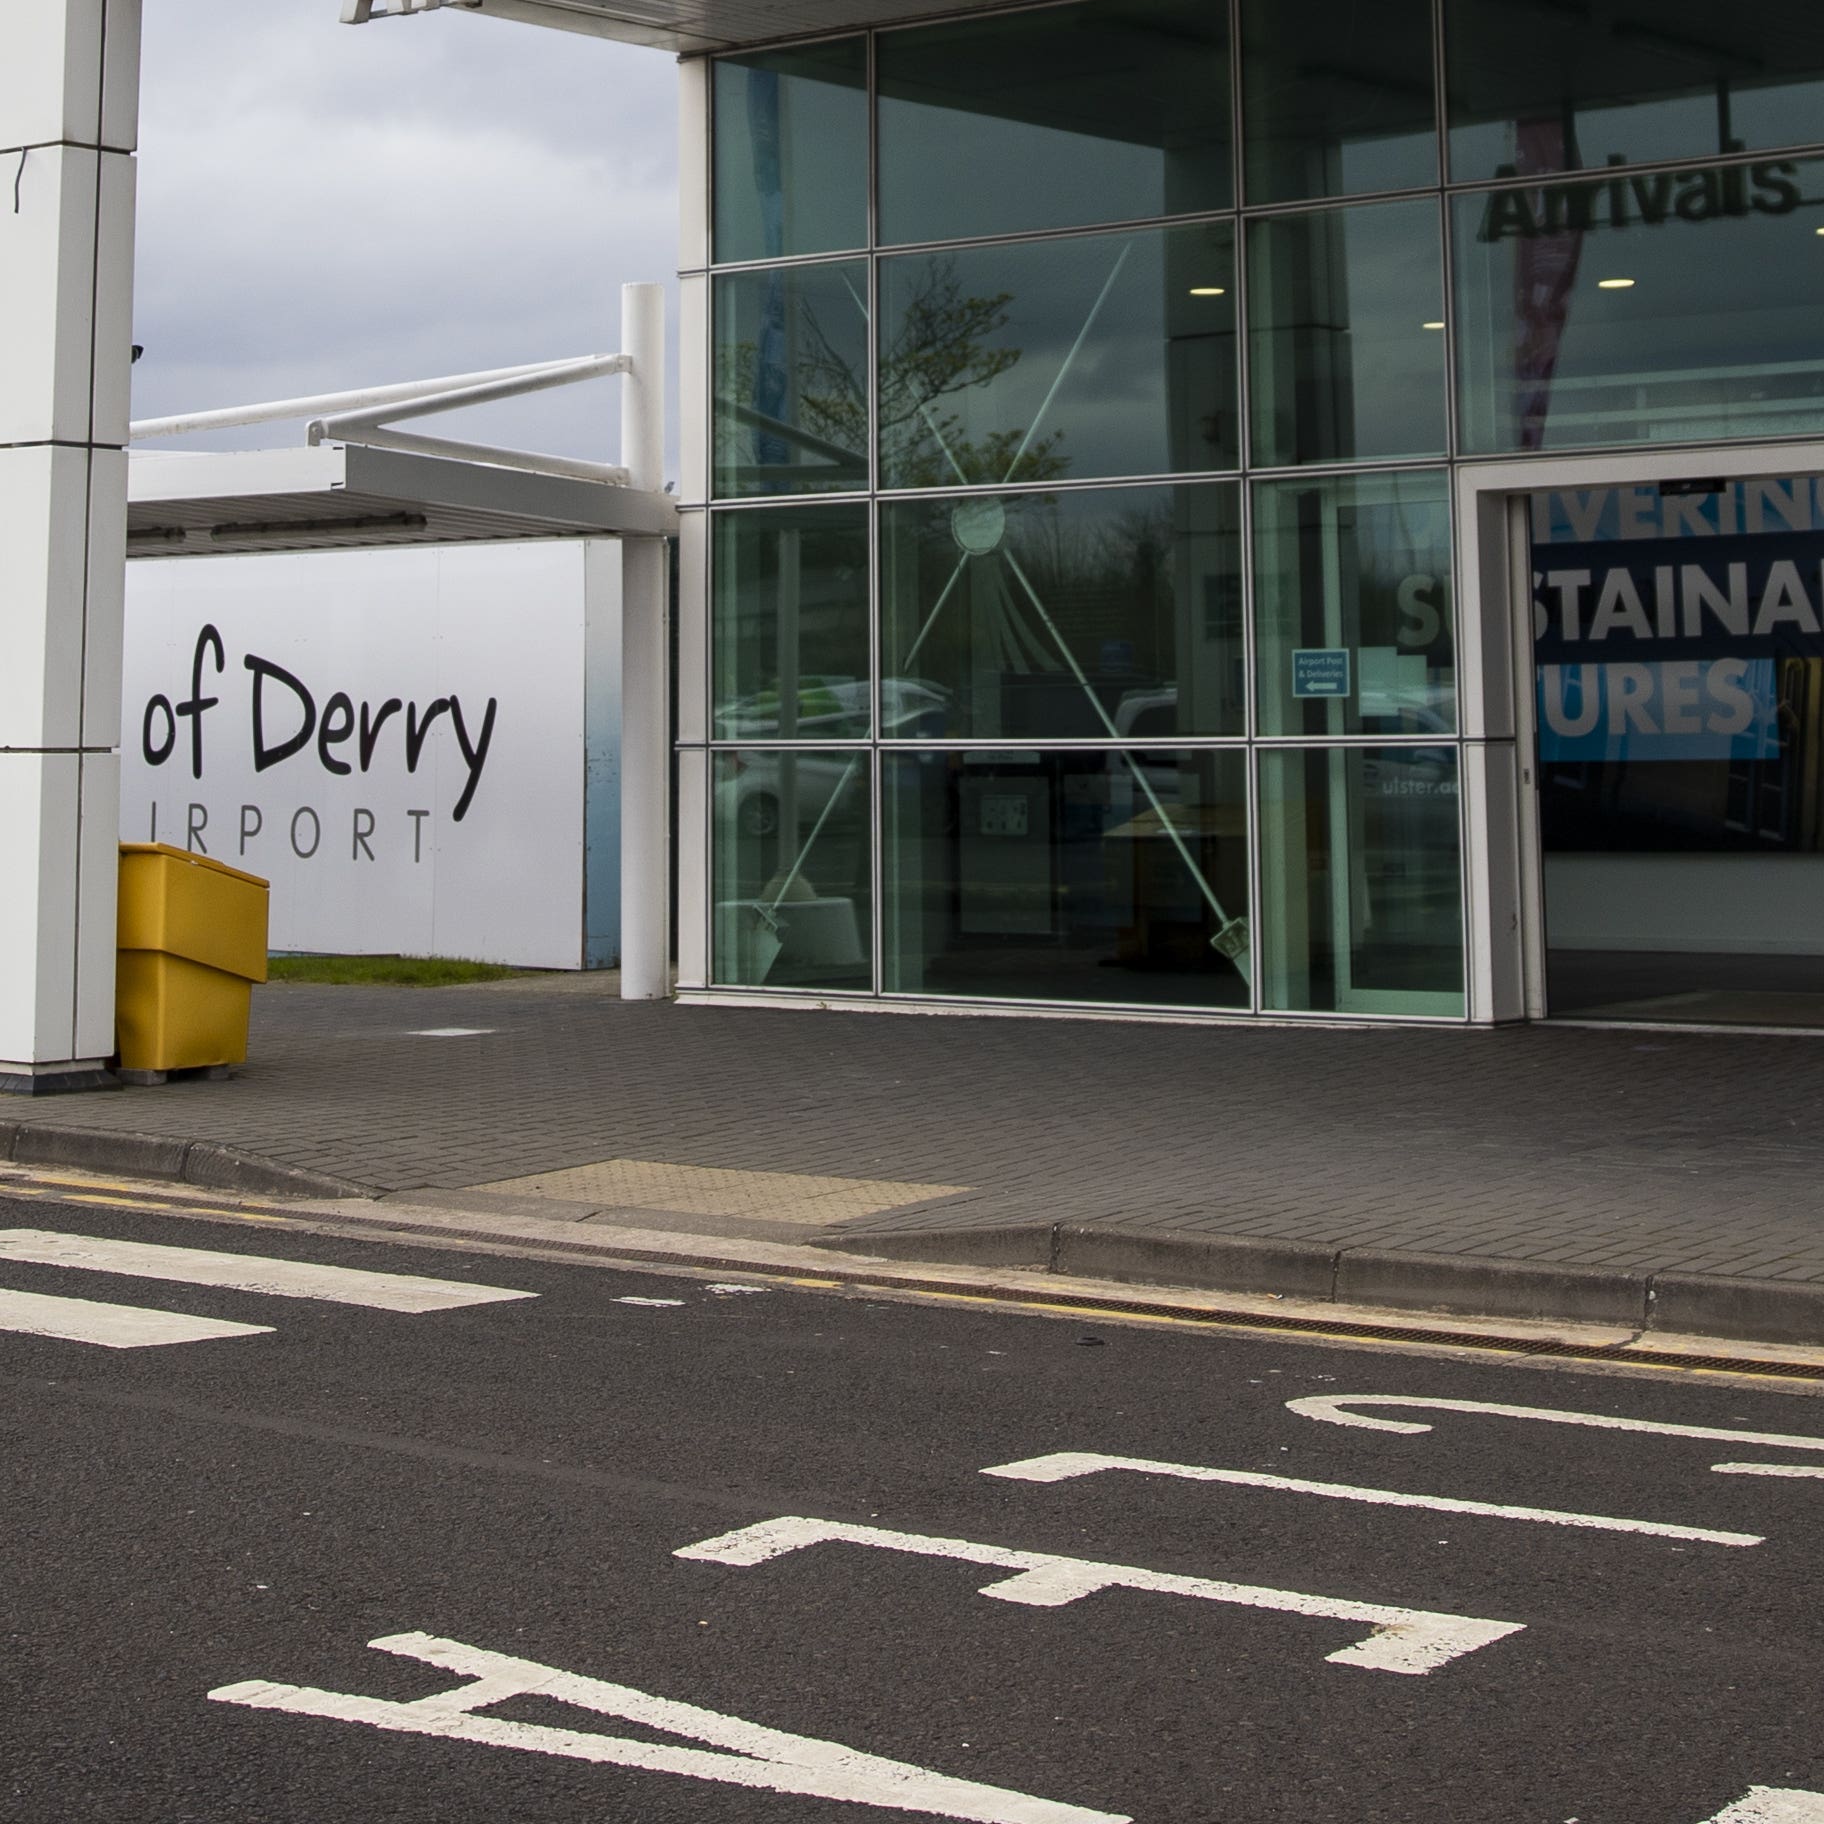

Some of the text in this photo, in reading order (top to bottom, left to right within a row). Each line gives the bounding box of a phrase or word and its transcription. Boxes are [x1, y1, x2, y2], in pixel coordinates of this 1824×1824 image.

[1297, 656, 1325, 667] Airport
[1542, 657, 1756, 738] URES
[142, 623, 497, 823] of Derry
[150, 800, 430, 863] IRPORT
